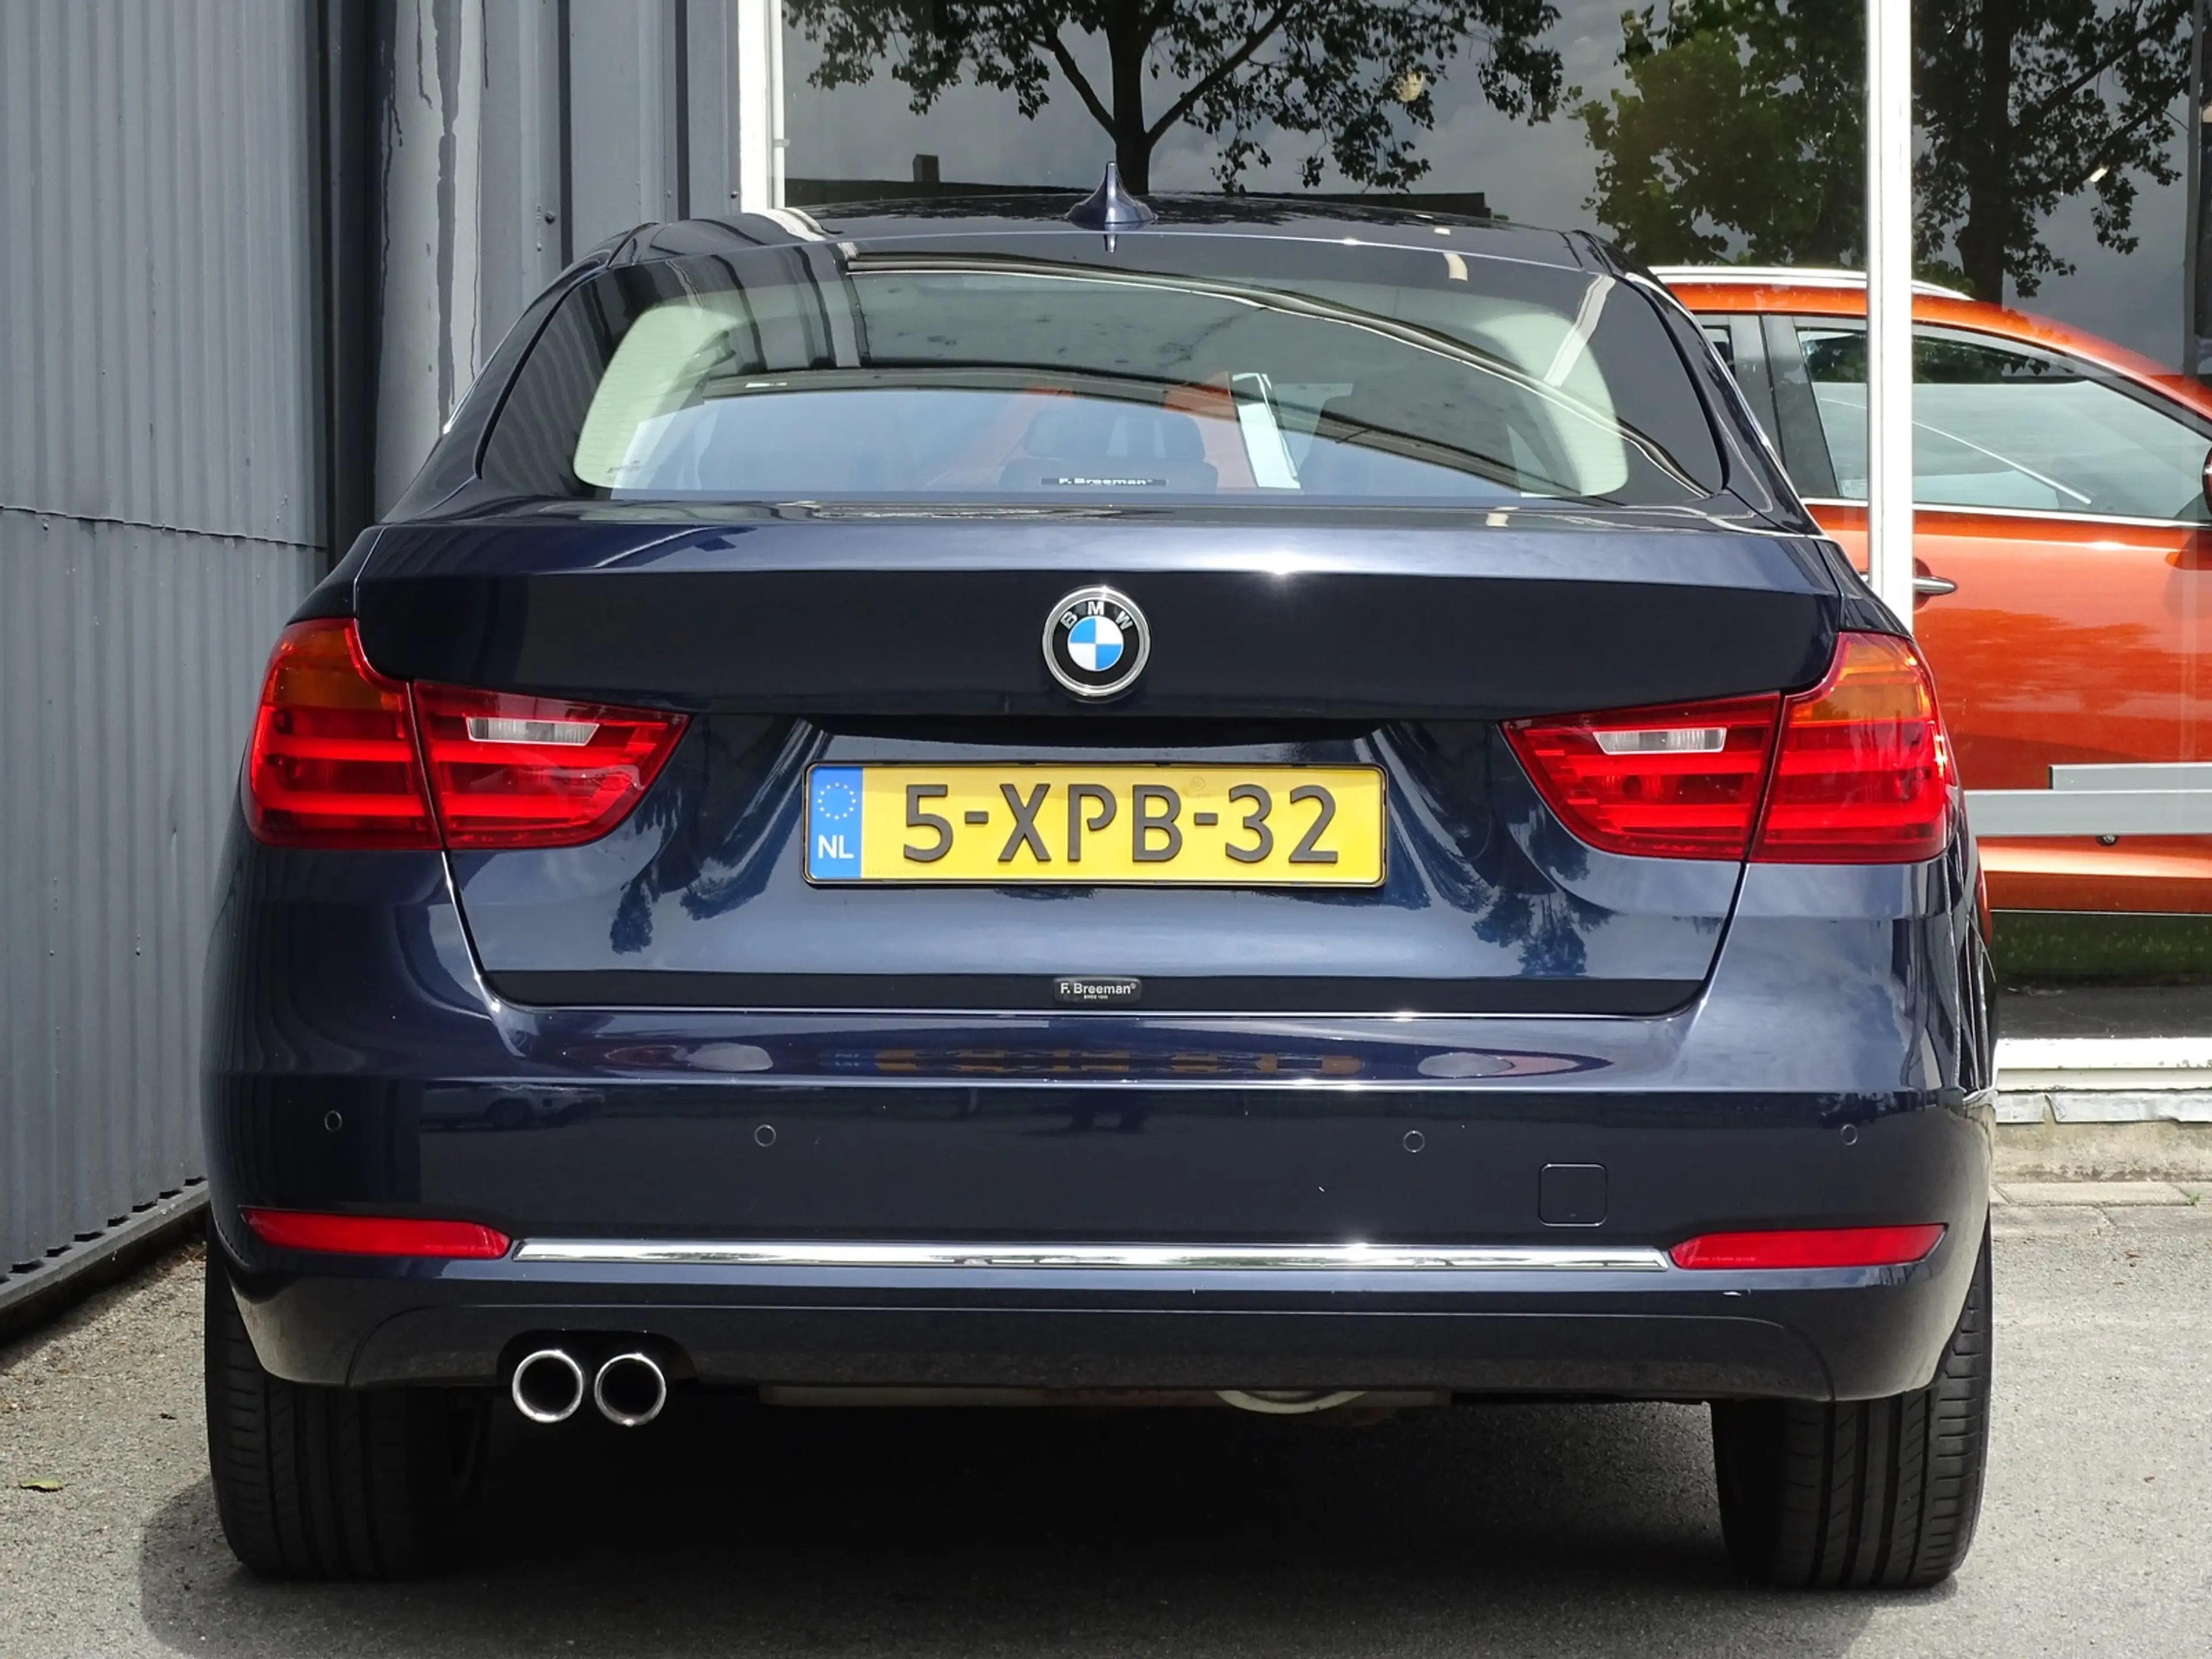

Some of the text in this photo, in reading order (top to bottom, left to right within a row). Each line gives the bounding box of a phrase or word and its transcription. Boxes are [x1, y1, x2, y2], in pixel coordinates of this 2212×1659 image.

[1060, 601, 1133, 630] BMW
[903, 783, 1339, 864] 5-XPB-32
[819, 835, 854, 859] NL
[1060, 982, 1071, 994] F.
